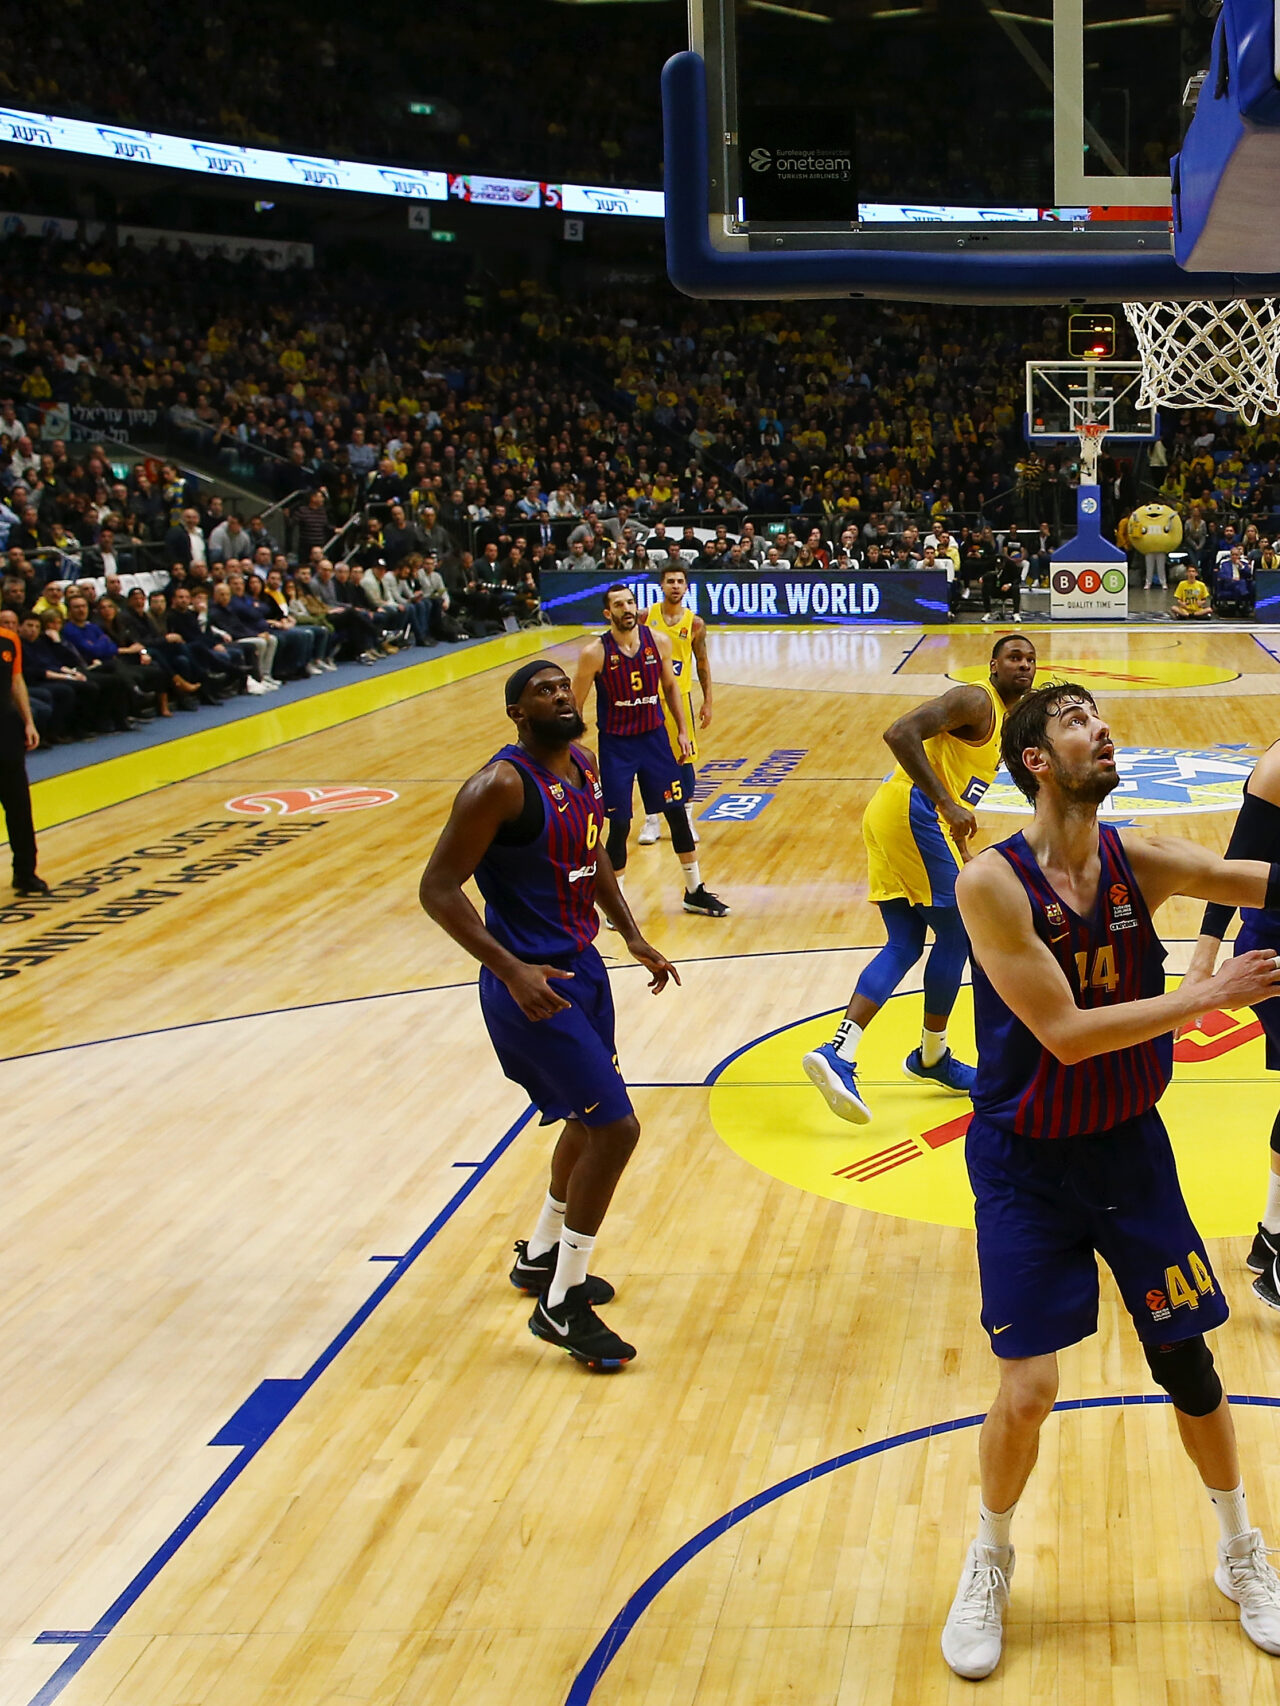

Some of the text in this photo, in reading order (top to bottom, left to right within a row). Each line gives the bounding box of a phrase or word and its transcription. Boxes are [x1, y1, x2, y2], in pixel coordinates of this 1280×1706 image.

[776, 157, 851, 171] oneteam
[450, 176, 465, 200] 4
[544, 184, 559, 207] 5
[413, 210, 424, 226] 4
[568, 222, 579, 237] 5
[1060, 575, 1118, 588] B B B
[706, 583, 777, 615] YOUR
[785, 583, 880, 615] WORLD
[1067, 601, 1093, 609] QUALITY
[630, 671, 643, 692] 5
[671, 780, 682, 801] 5
[708, 795, 763, 820] FOX
[586, 812, 598, 851] 6
[153, 820, 331, 885] TURKISH
[1164, 1250, 1216, 1311] 44
